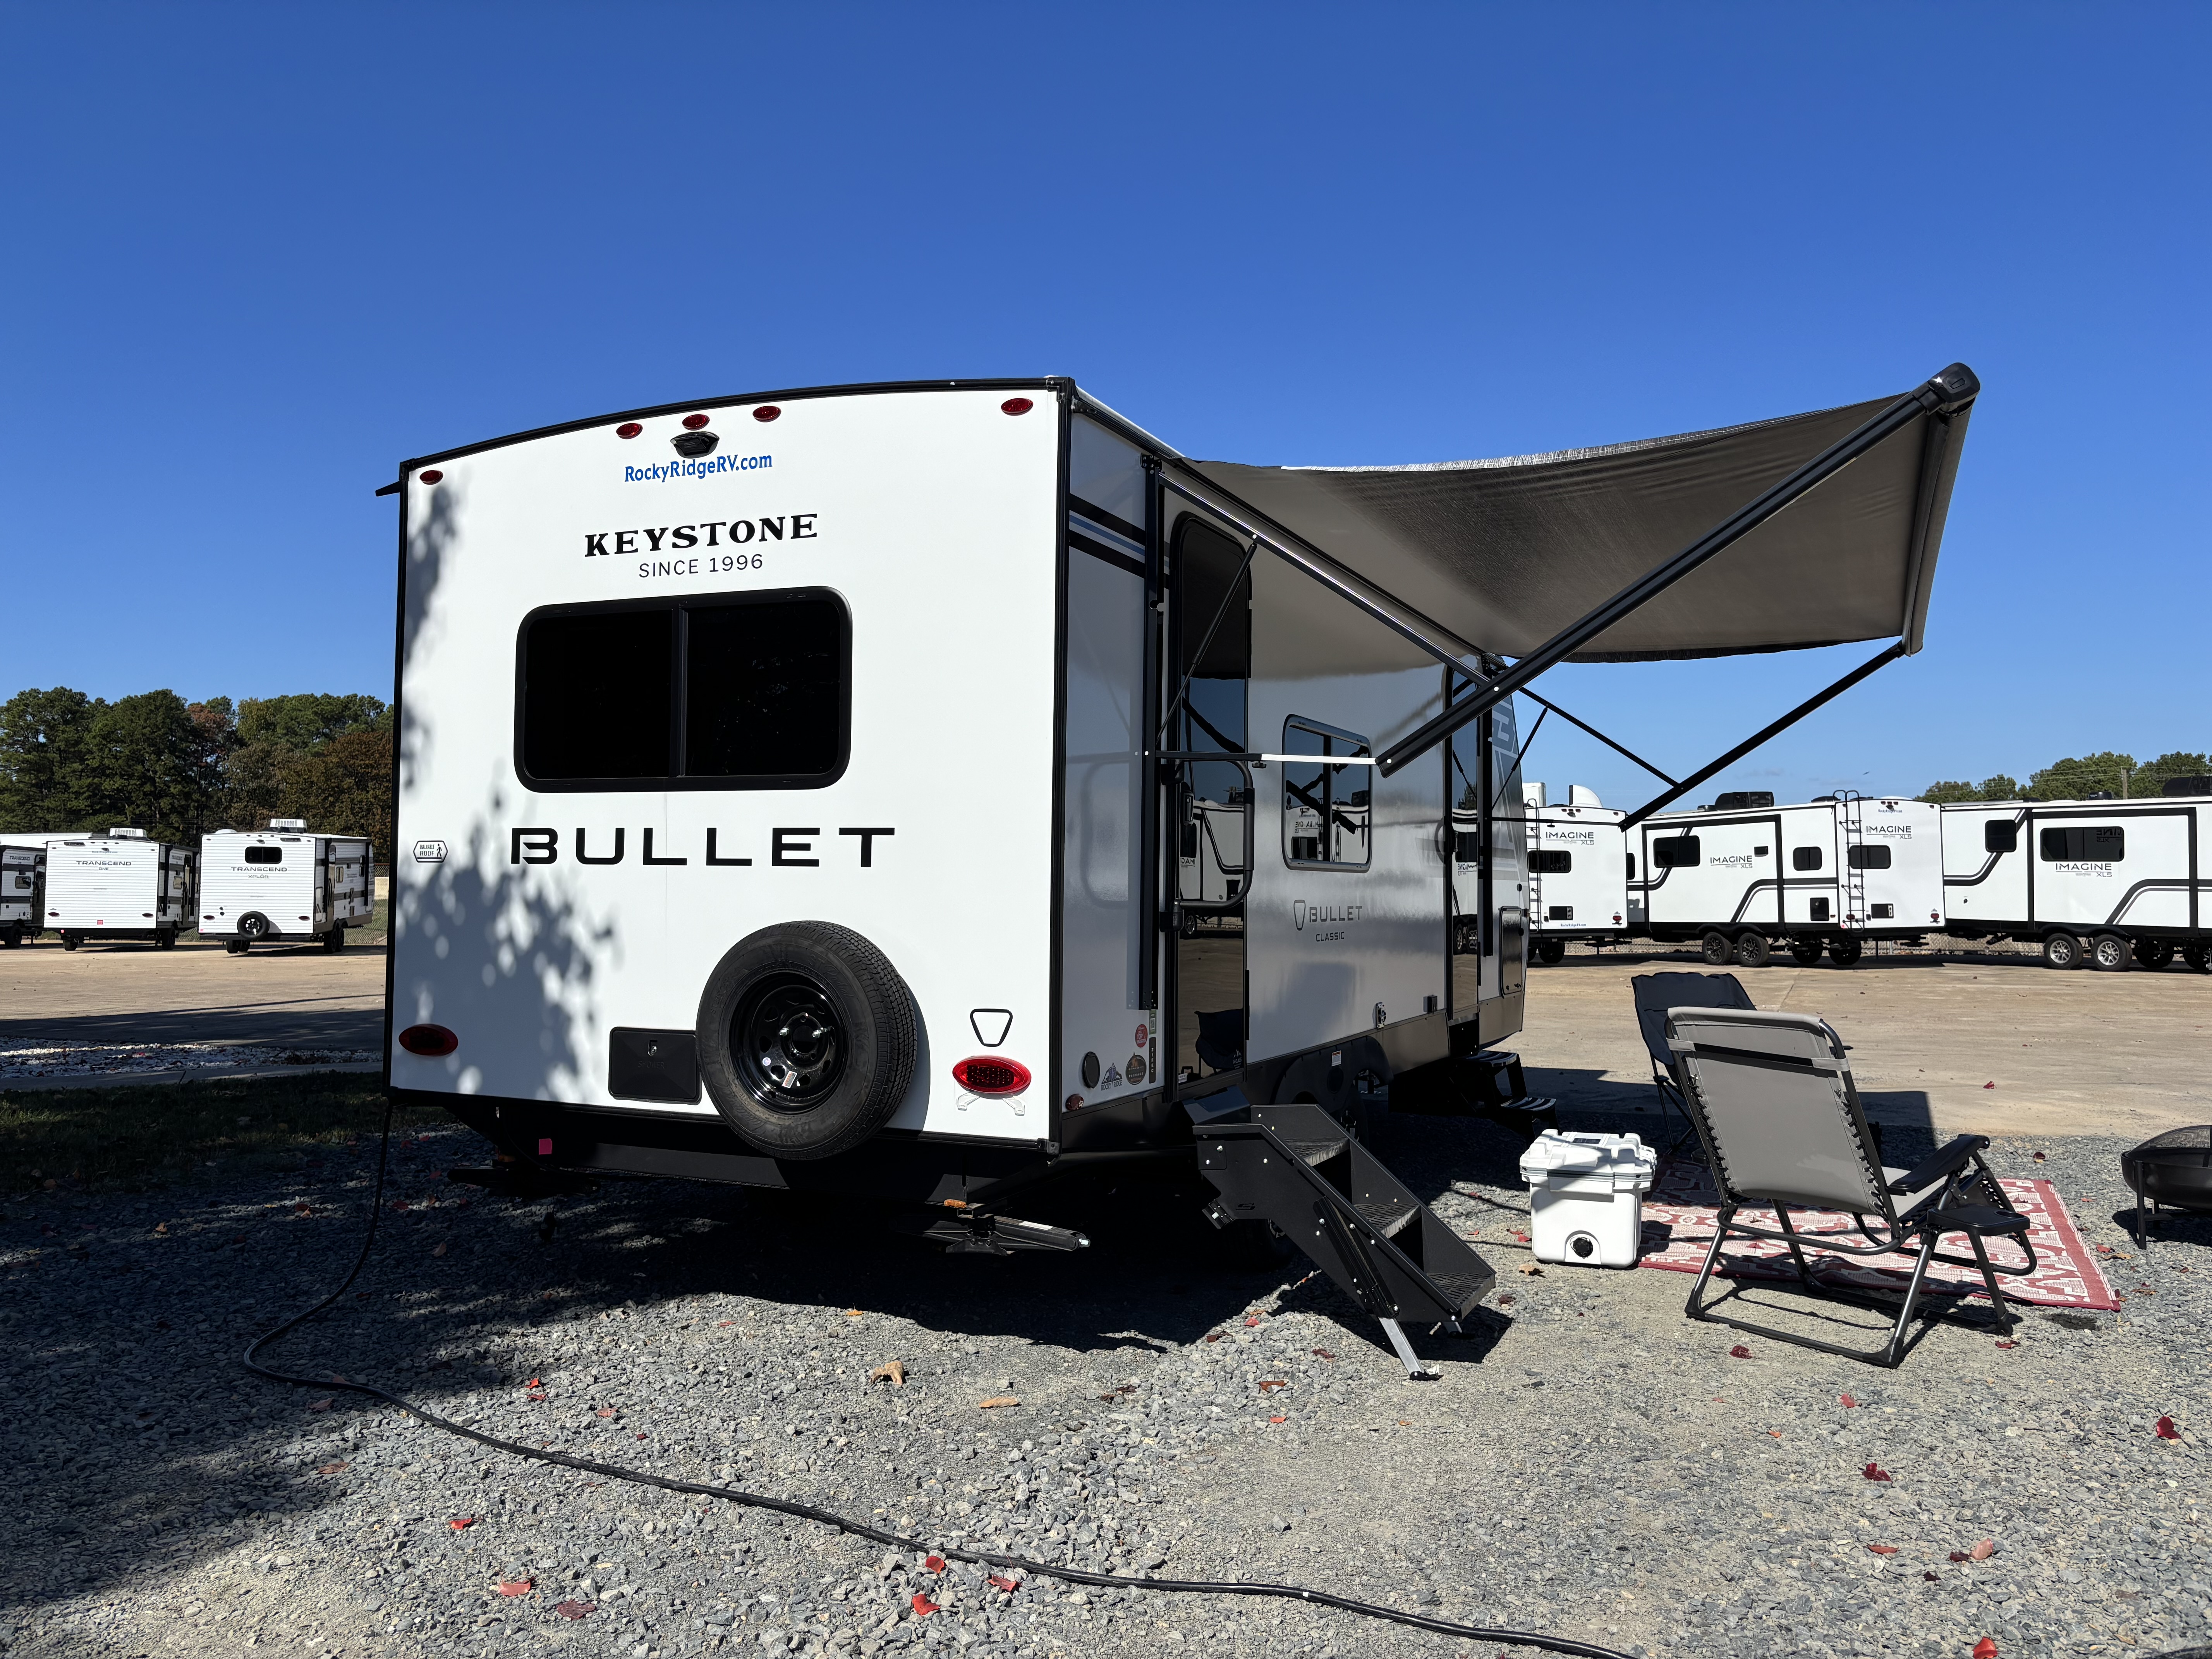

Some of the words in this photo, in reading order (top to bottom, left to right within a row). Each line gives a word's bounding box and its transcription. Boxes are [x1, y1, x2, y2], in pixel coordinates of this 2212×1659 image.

[624, 454, 773, 482] RockyRidgeRV.com
[584, 513, 817, 557] KEYSTONE
[639, 559, 699, 578] SINCE
[709, 554, 763, 572] 1996
[511, 827, 895, 868] BULLET
[1710, 855, 1752, 864] IMAGINE
[1309, 906, 1362, 922] BULLET
[1316, 931, 1345, 942] CLASSIC
[638, 1060, 665, 1069] SHOWER
